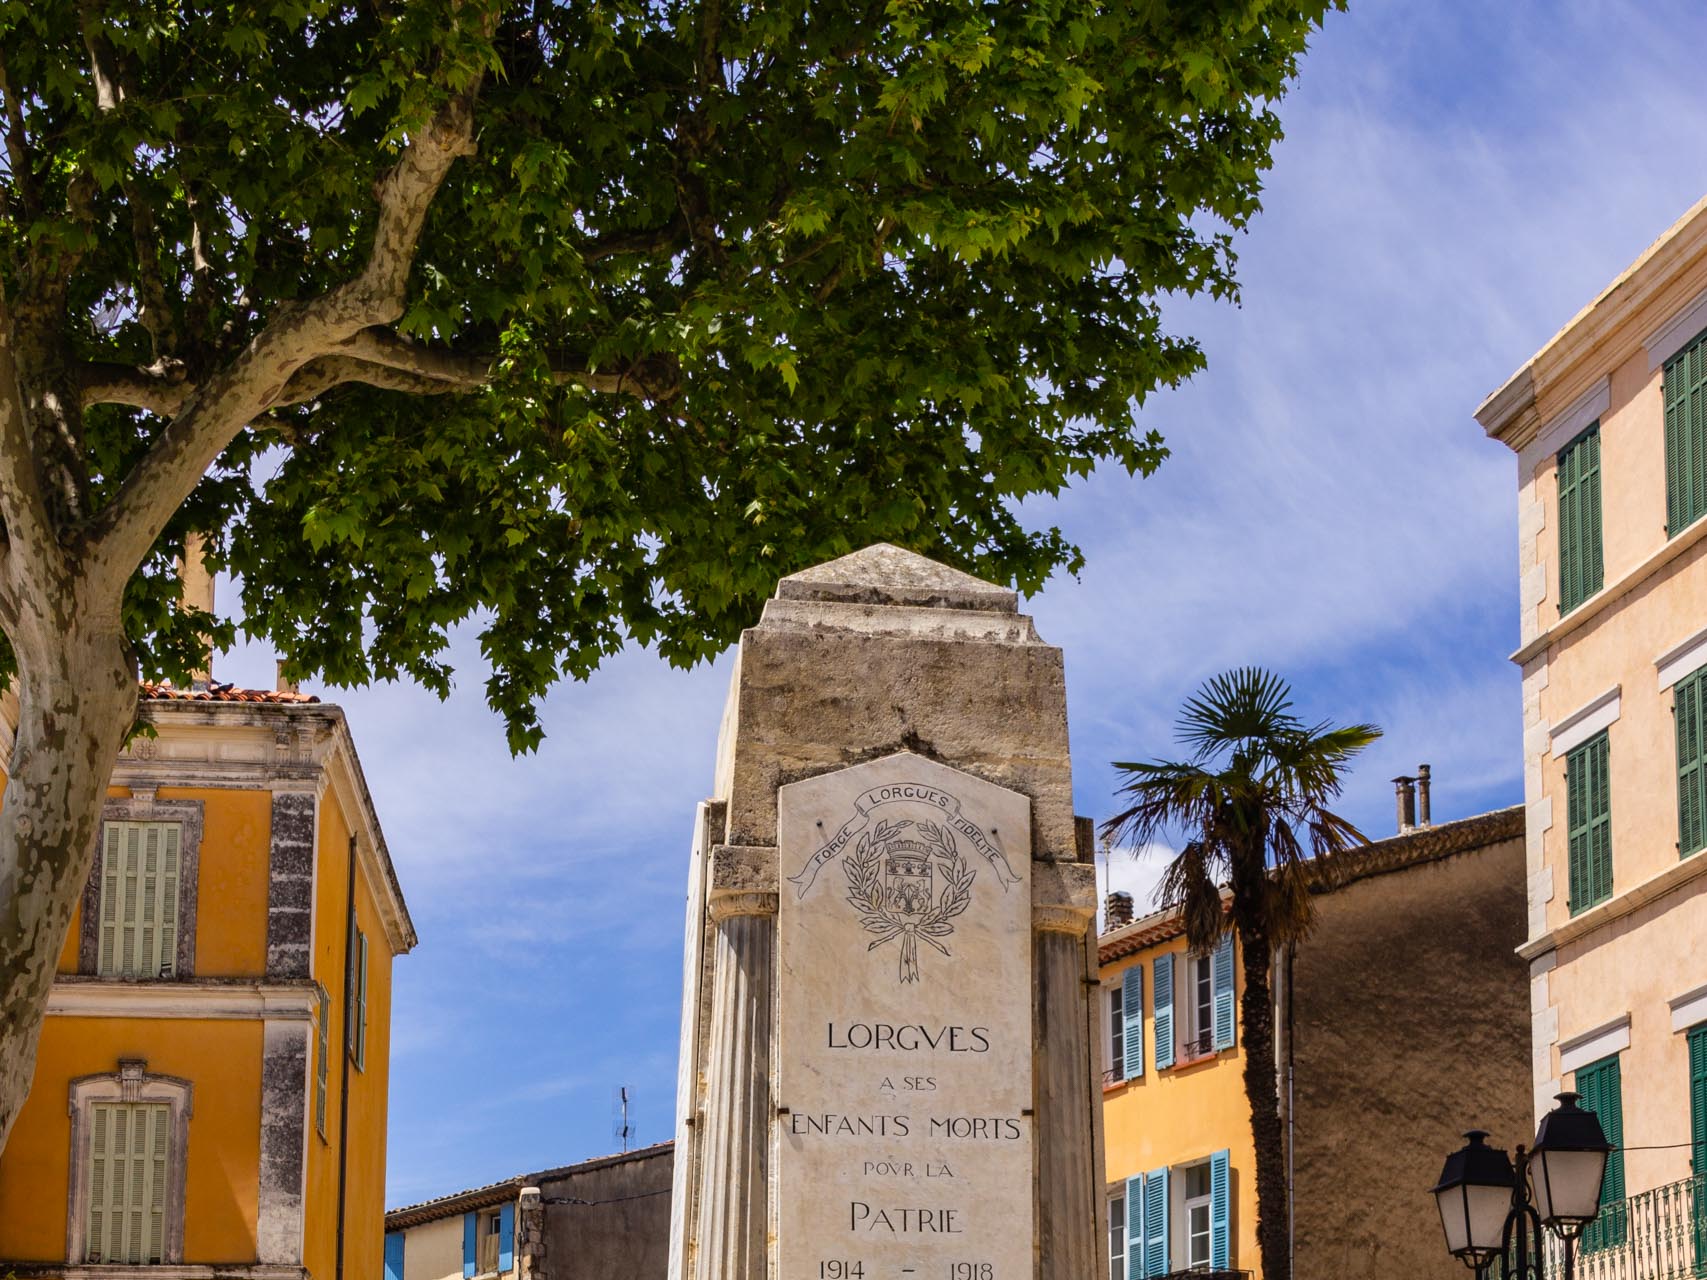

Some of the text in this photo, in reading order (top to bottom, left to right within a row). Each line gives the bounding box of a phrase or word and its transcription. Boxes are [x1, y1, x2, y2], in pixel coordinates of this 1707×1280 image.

[869, 787, 949, 807] LORGUES
[815, 827, 852, 864] FORCE
[954, 818, 1000, 862] FIDELITE
[828, 1023, 989, 1052] LORGVES
[880, 1076, 936, 1090] A SES
[792, 1114, 1021, 1139] ENFANTS MORTS
[864, 1162, 954, 1177] POVR LA
[851, 1202, 962, 1232] PATRIE
[820, 1260, 865, 1280] 1914
